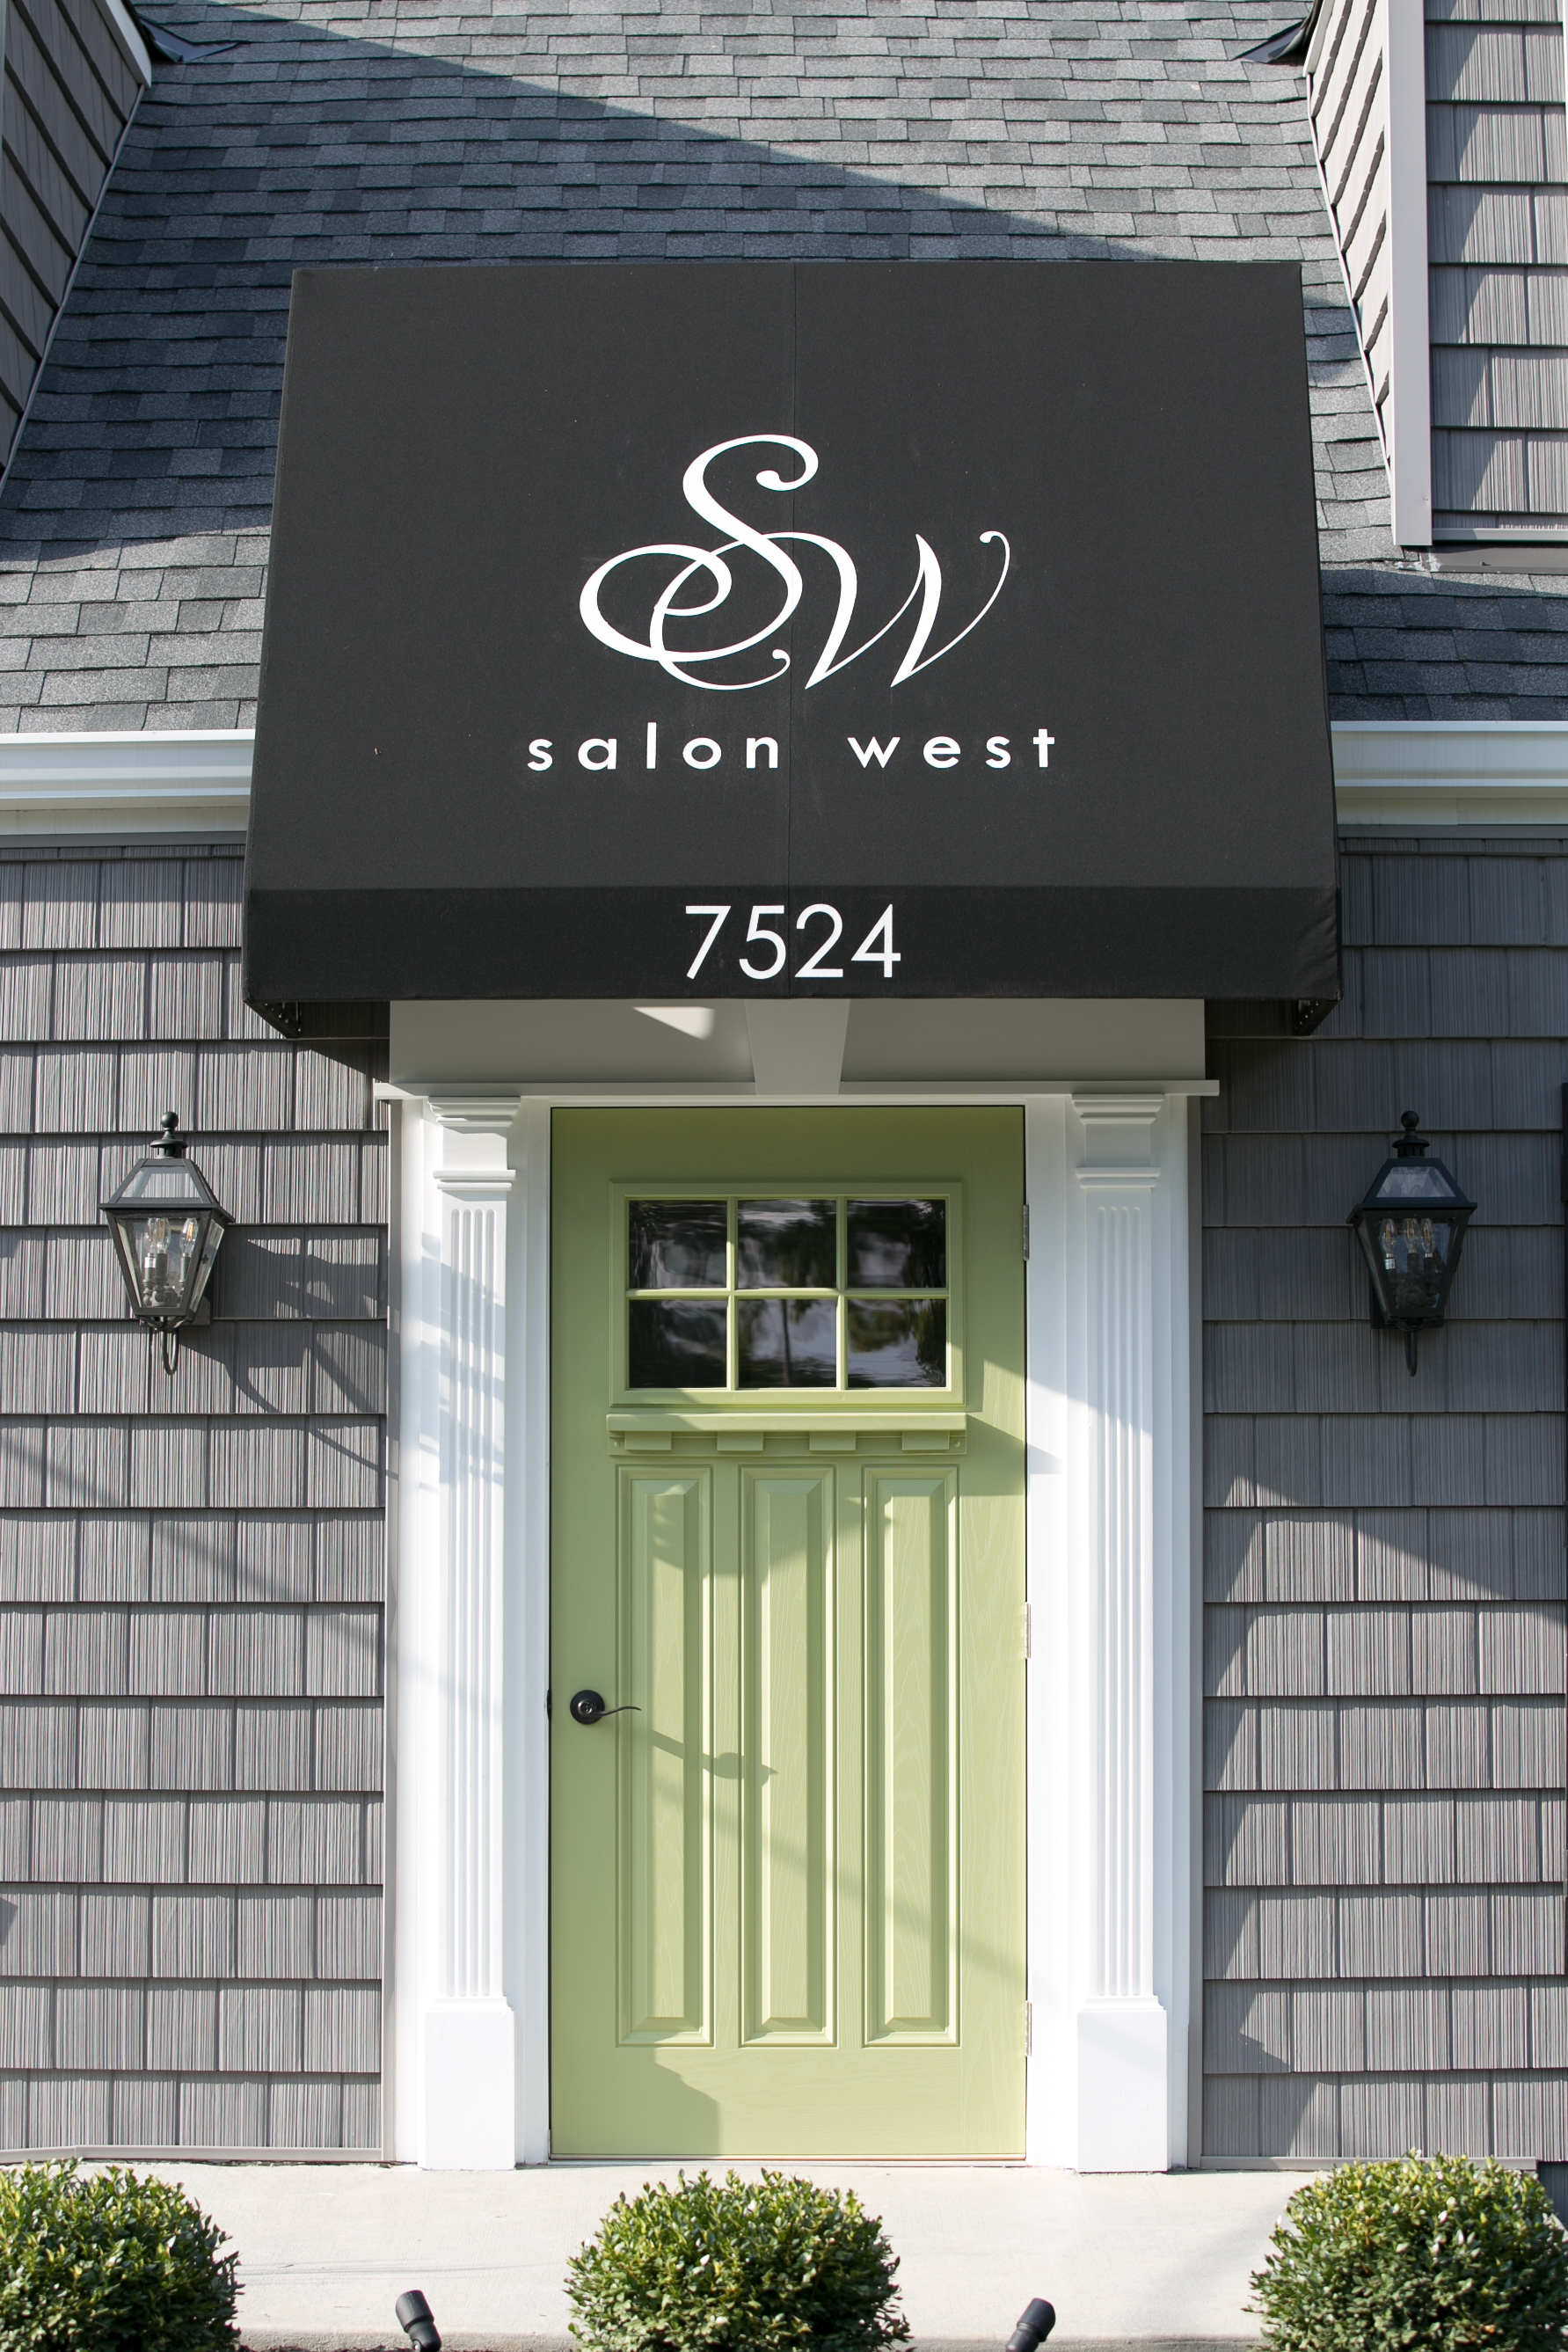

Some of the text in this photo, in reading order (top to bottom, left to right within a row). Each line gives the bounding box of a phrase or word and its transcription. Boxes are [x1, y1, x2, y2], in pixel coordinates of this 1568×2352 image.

[527, 721, 1055, 771] salon west
[684, 903, 901, 980] 7524
